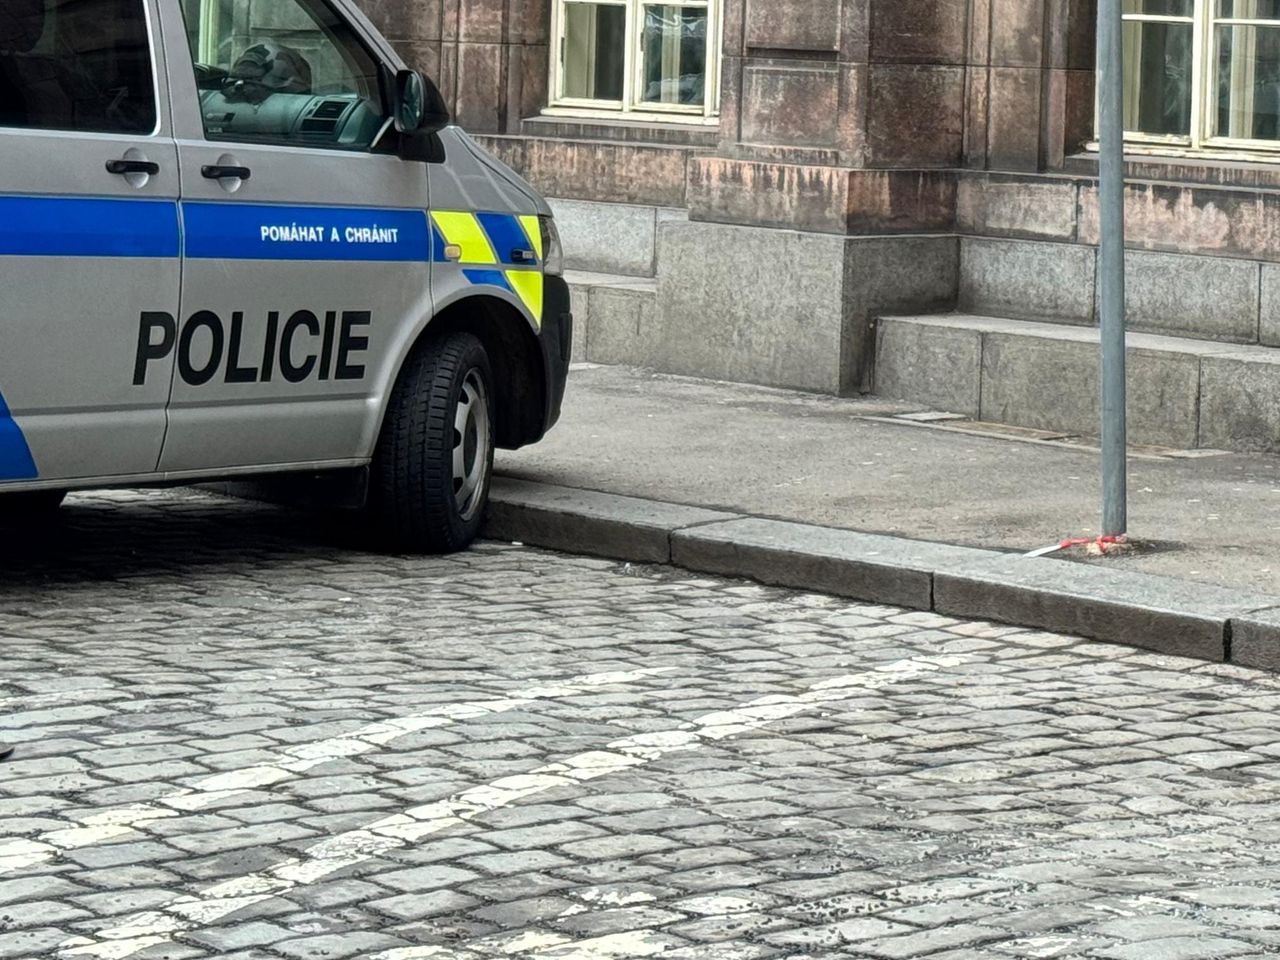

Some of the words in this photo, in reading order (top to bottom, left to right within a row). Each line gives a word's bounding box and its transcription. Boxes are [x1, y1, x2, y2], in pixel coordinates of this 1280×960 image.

[260, 222, 324, 242] POMÁHAT
[330, 226, 340, 242] A
[345, 224, 399, 243] CHRÁNIT
[132, 309, 372, 386] POLICIE
